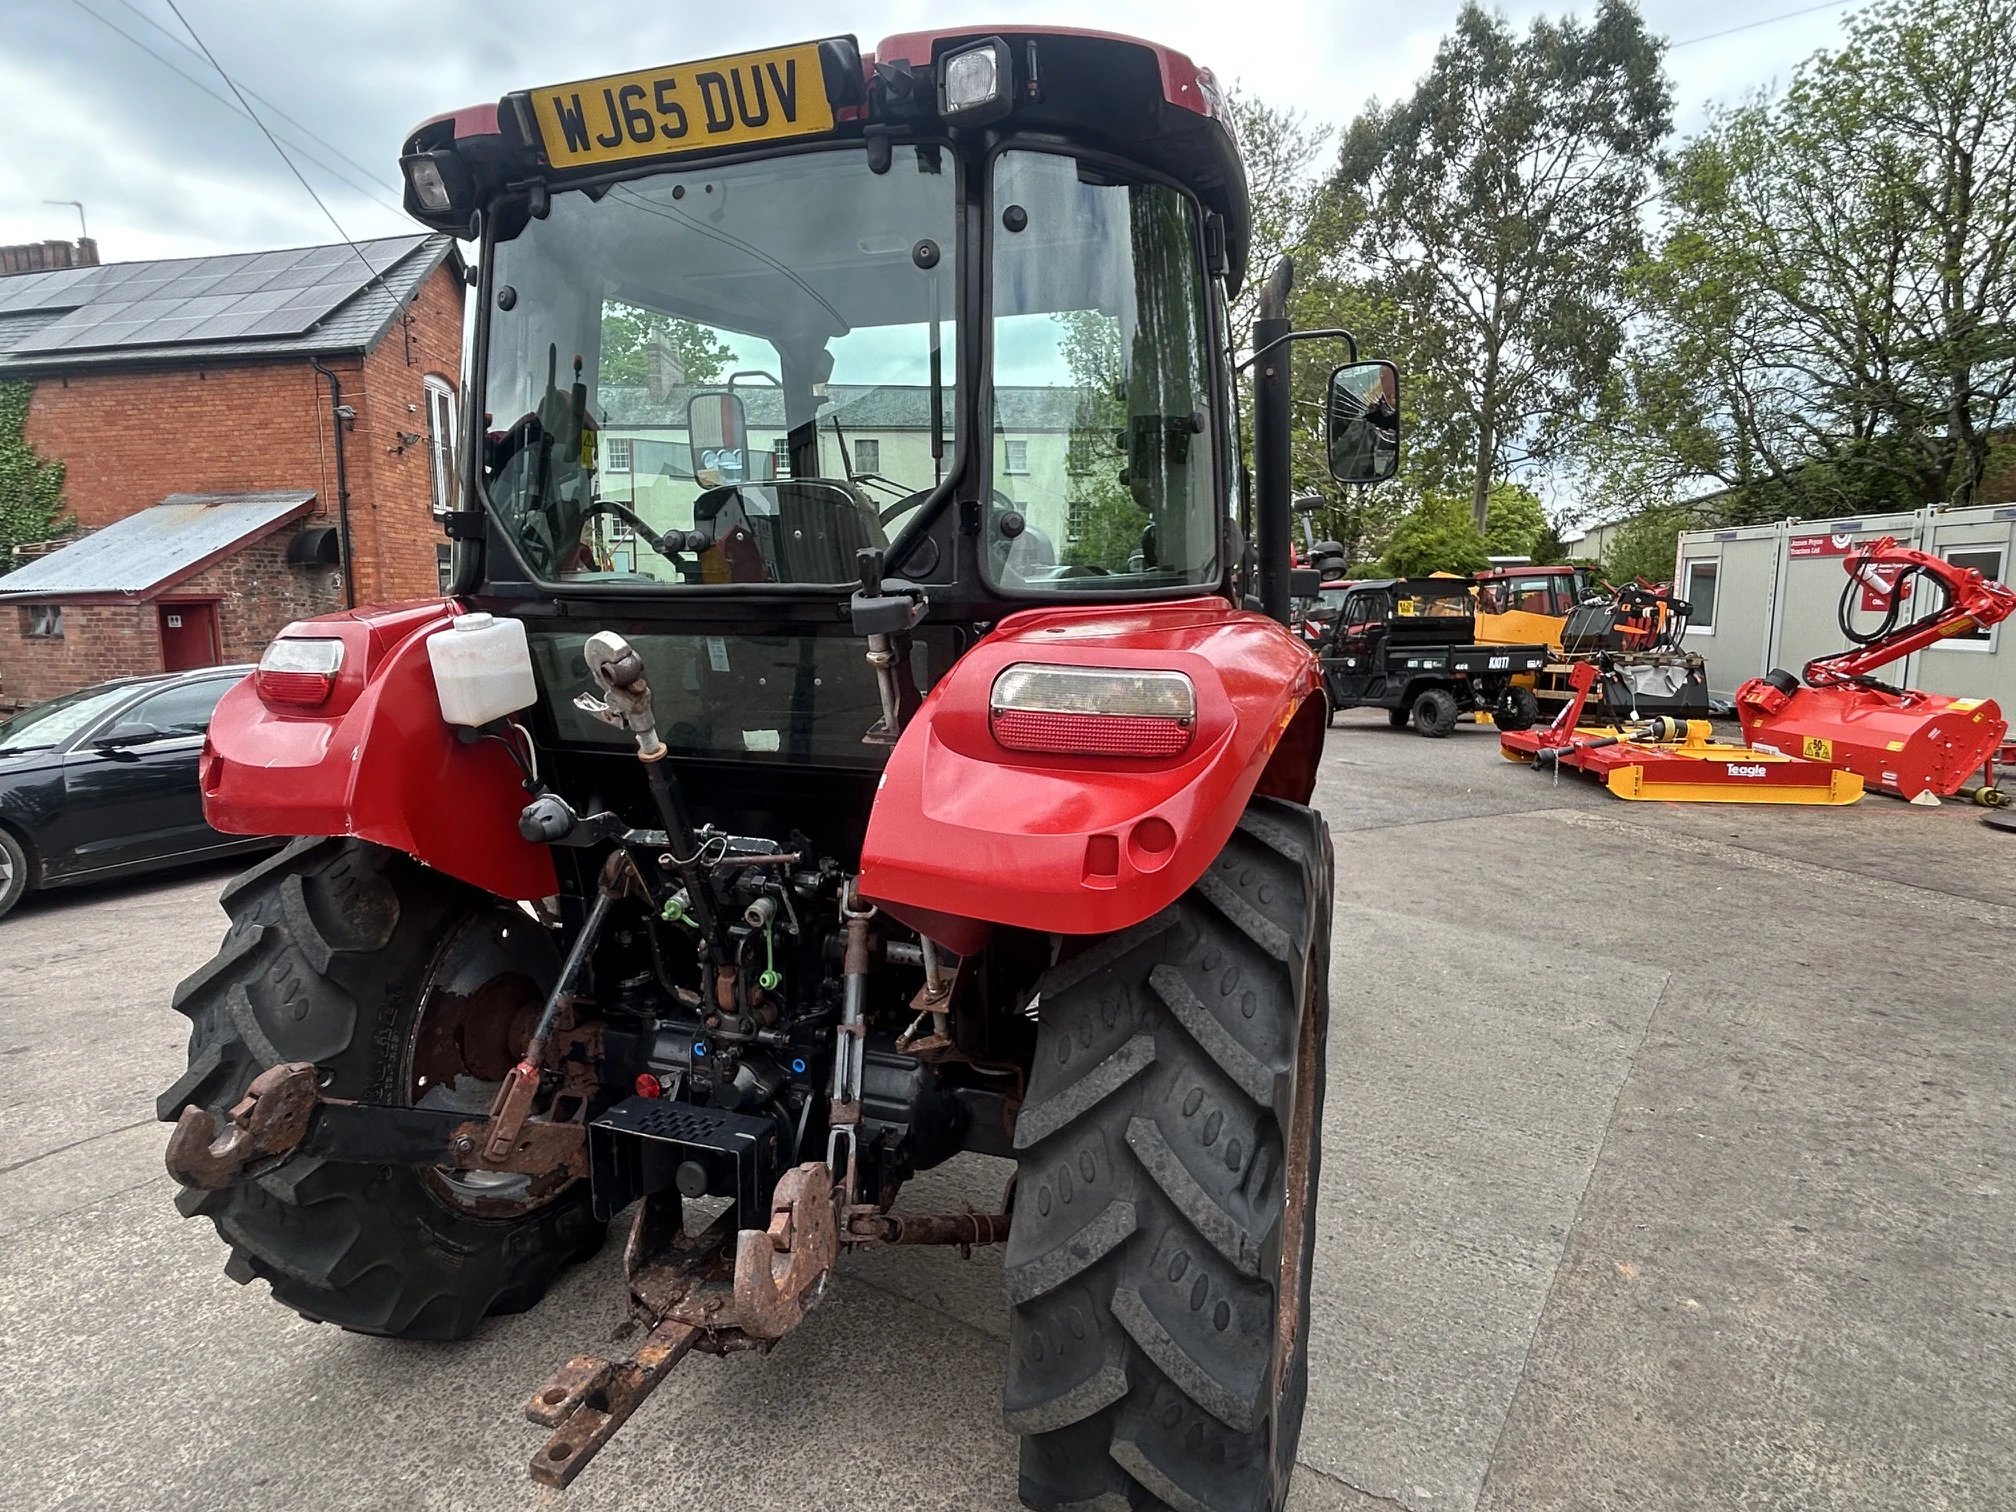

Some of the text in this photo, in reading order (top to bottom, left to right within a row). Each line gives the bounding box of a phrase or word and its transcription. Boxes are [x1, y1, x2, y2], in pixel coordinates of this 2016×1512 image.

[552, 59, 796, 153] WJ65 DUV
[1488, 656, 1510, 670] KIOTI
[1813, 739, 1823, 751] 50
[1726, 763, 1767, 777] Teagle
